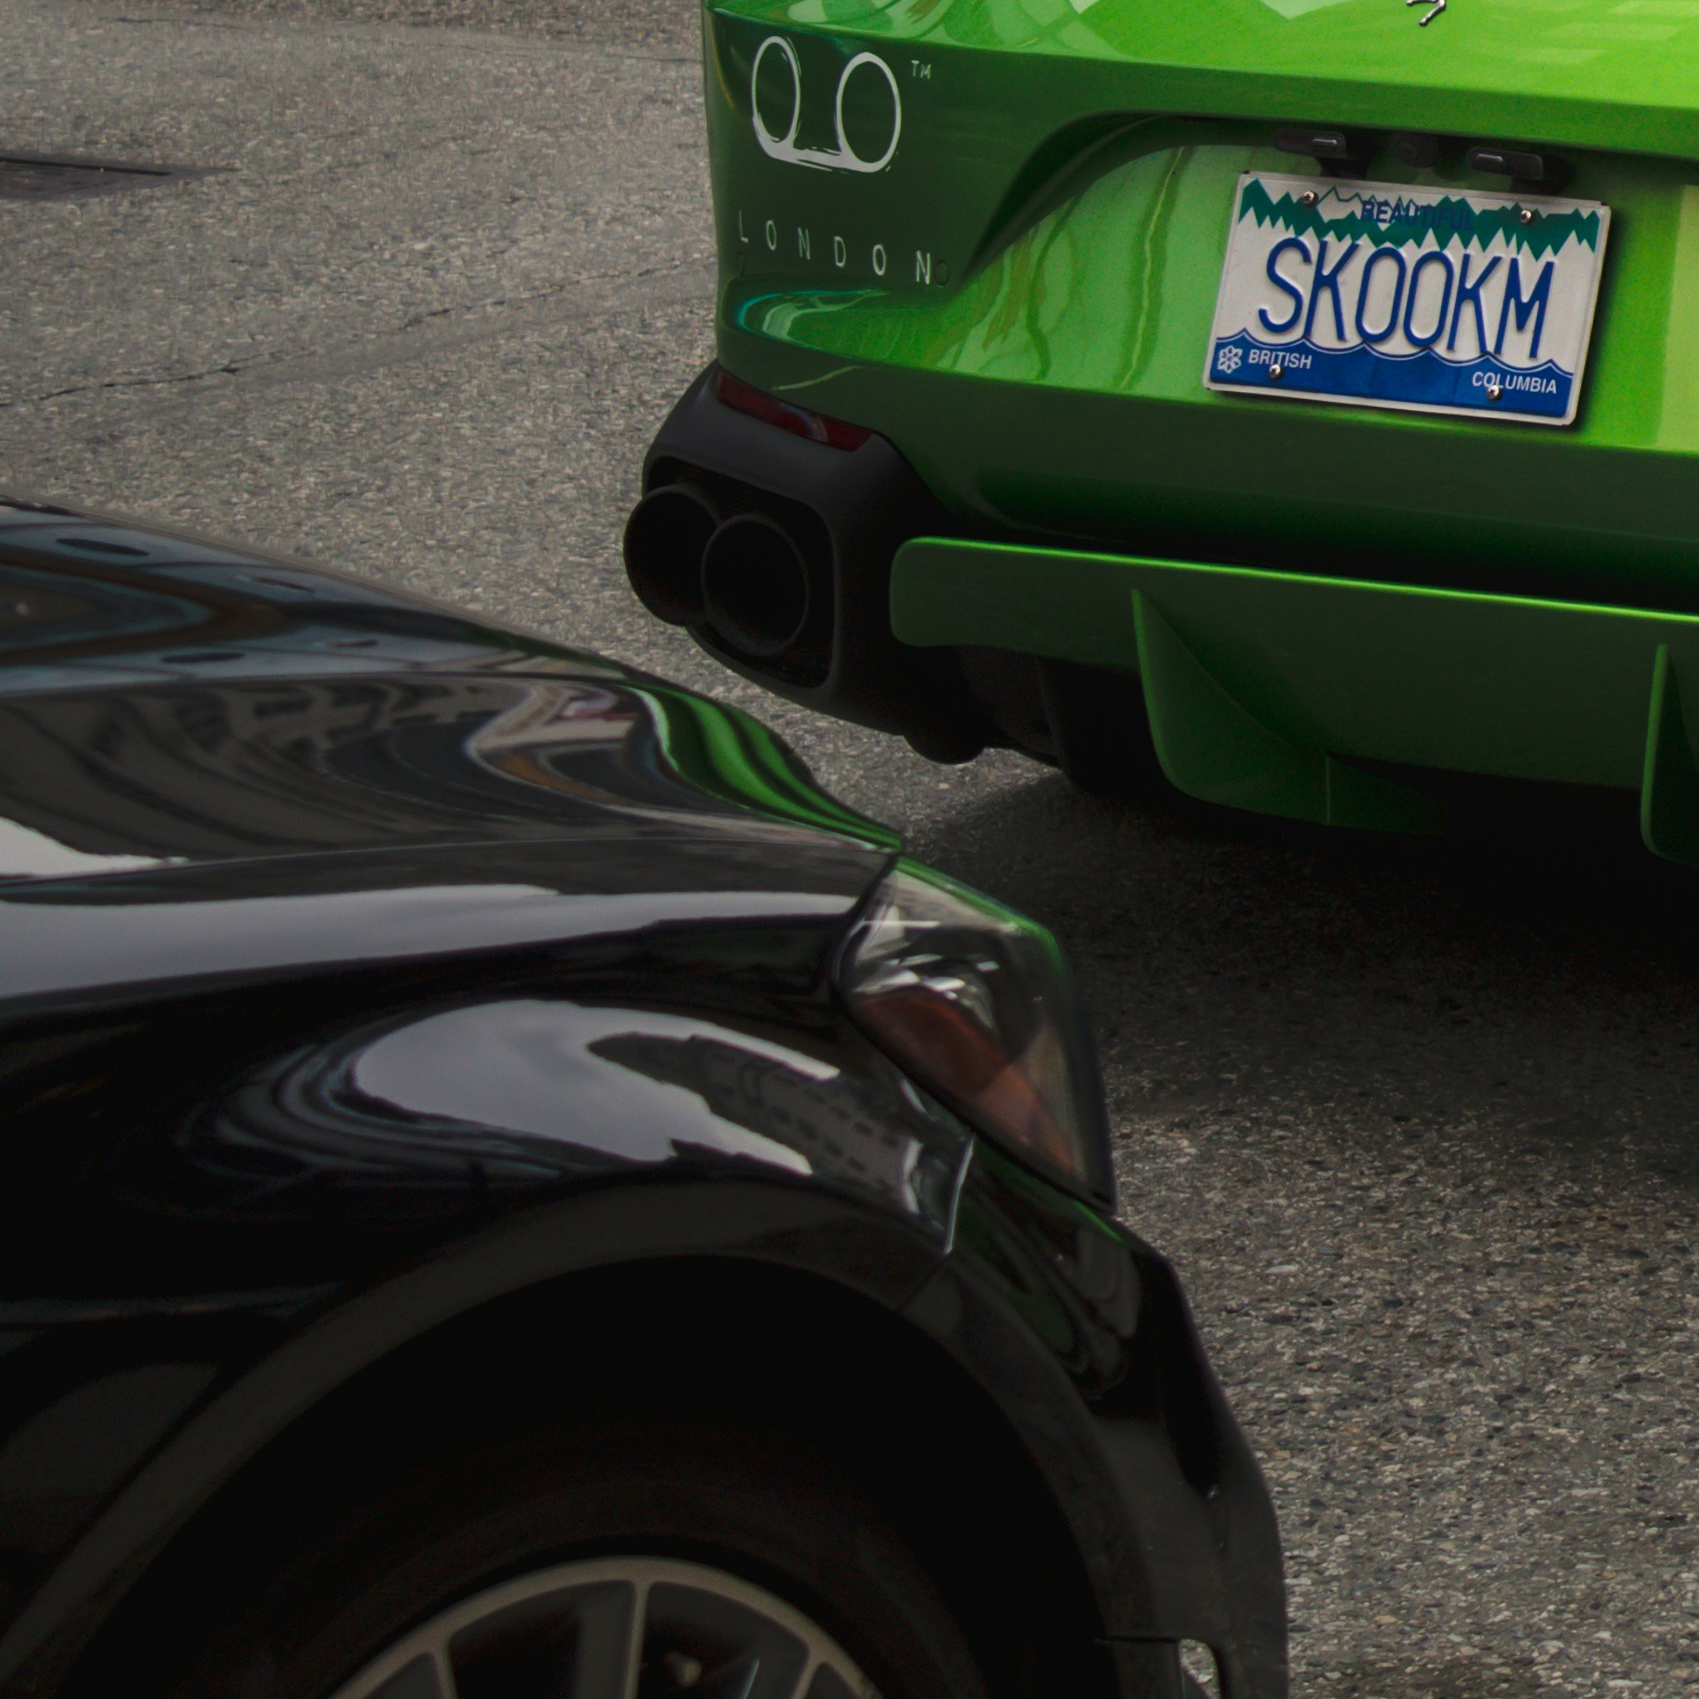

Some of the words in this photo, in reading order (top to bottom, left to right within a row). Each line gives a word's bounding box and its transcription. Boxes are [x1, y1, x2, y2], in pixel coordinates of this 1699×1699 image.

[1359, 199, 1475, 232] BEAUTIFUL
[738, 209, 932, 286] LONDON
[1257, 236, 1555, 360] SKOOKM
[1248, 350, 1313, 370] BRITISH
[1471, 371, 1558, 395] COLUMBIA
